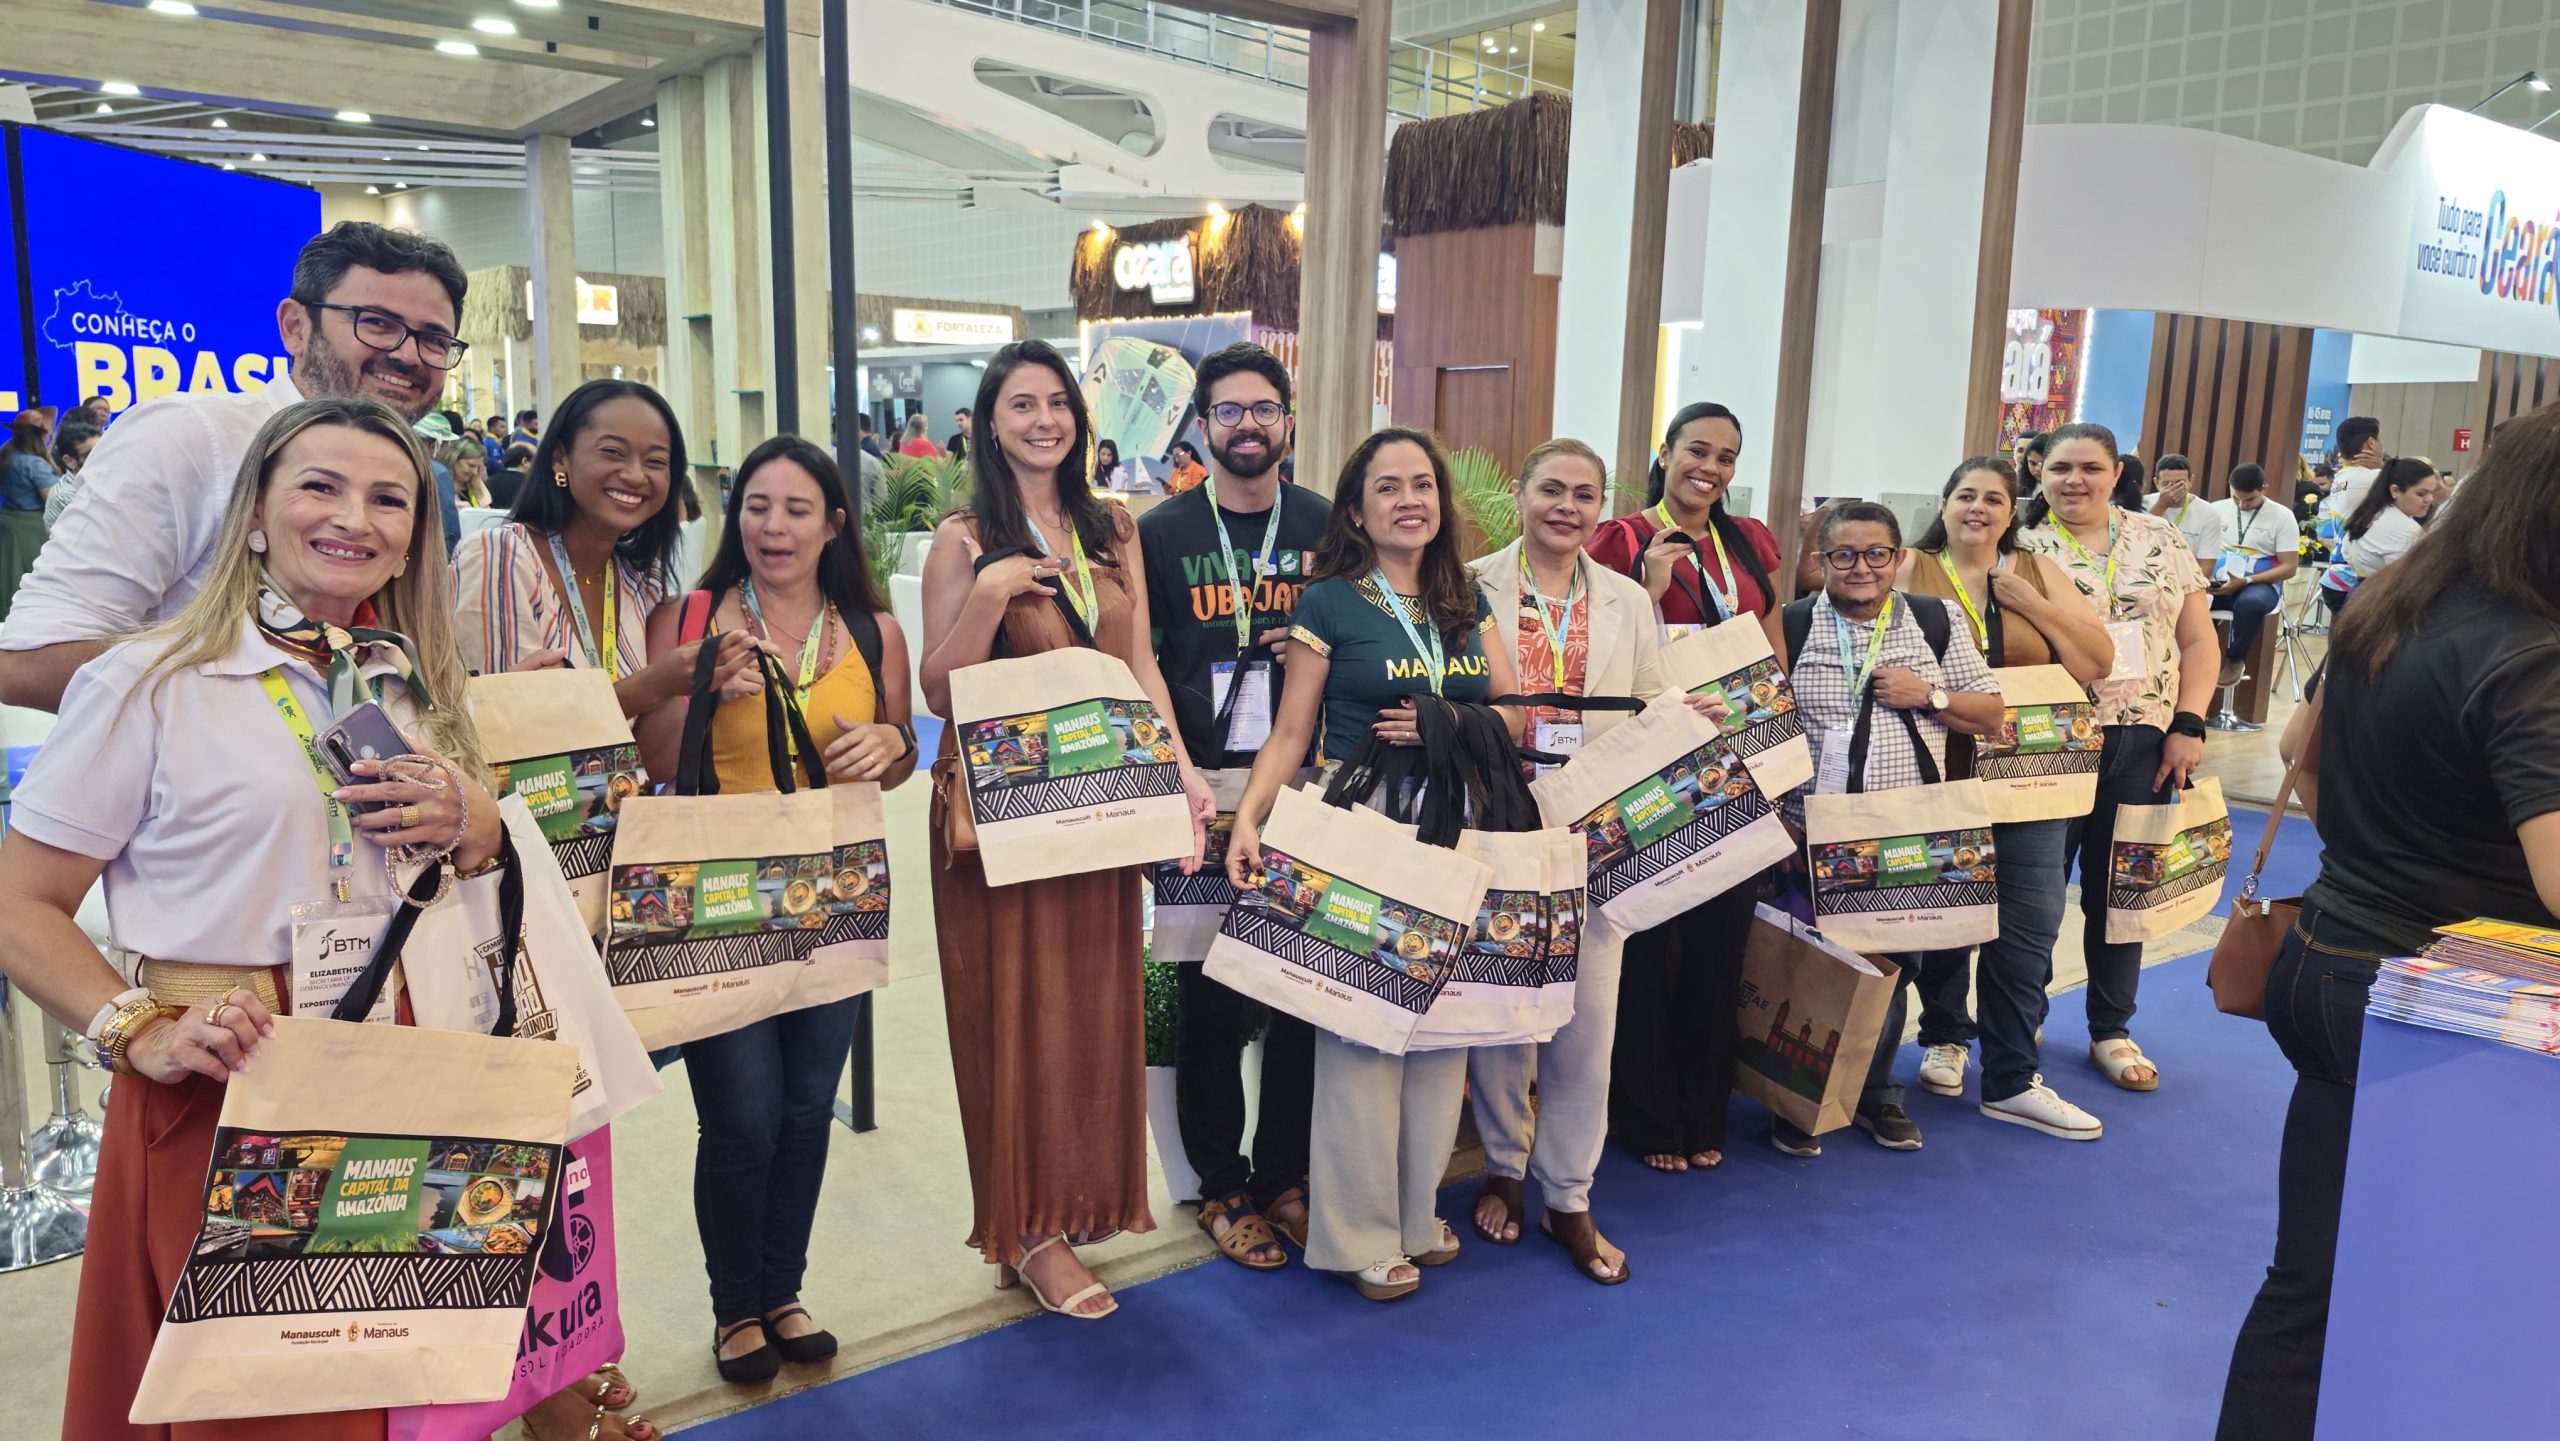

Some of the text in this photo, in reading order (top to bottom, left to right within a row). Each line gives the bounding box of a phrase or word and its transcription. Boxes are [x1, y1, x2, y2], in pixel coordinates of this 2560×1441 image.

[2438, 197, 2483, 243] Tudo para
[2417, 238, 2477, 279] você curtir o
[72, 312, 196, 344] CONHEÇA O
[936, 321, 1003, 334] FORTALEZA
[2461, 438, 2470, 449] H
[1180, 548, 1251, 585] VIVA
[1385, 656, 1490, 680] MAAUS
[1053, 712, 1101, 736] MANAUS
[1057, 728, 1090, 744] CAPITAL
[1557, 736, 1577, 744] BTM
[515, 770, 567, 796] MANAUS
[524, 786, 569, 807] APITAL DA
[1625, 785, 1666, 817] MANAUS
[533, 798, 574, 819] MAZÔNIA
[1632, 802, 1660, 824] CAPITAL
[1883, 844, 1923, 860] MANAUS
[1886, 855, 1913, 867] CAPITAL
[702, 873, 750, 893] MANAUS
[703, 886, 750, 905] CAPITAL DA
[1329, 891, 1375, 916] MANAUS
[1327, 903, 1358, 920] CAPITAL
[334, 936, 371, 953] BTM
[309, 966, 353, 979] ELIZABETH
[721, 979, 750, 990] Manaus
[1325, 986, 1353, 1002] Manaus
[299, 999, 340, 1009] EXPOSITOR
[343, 1157, 418, 1180] MANAUS
[340, 1176, 410, 1197] CAPITAL DA
[335, 1192, 408, 1218] AMAZÔNIA
[280, 1326, 409, 1340] Manauscult Manaus
